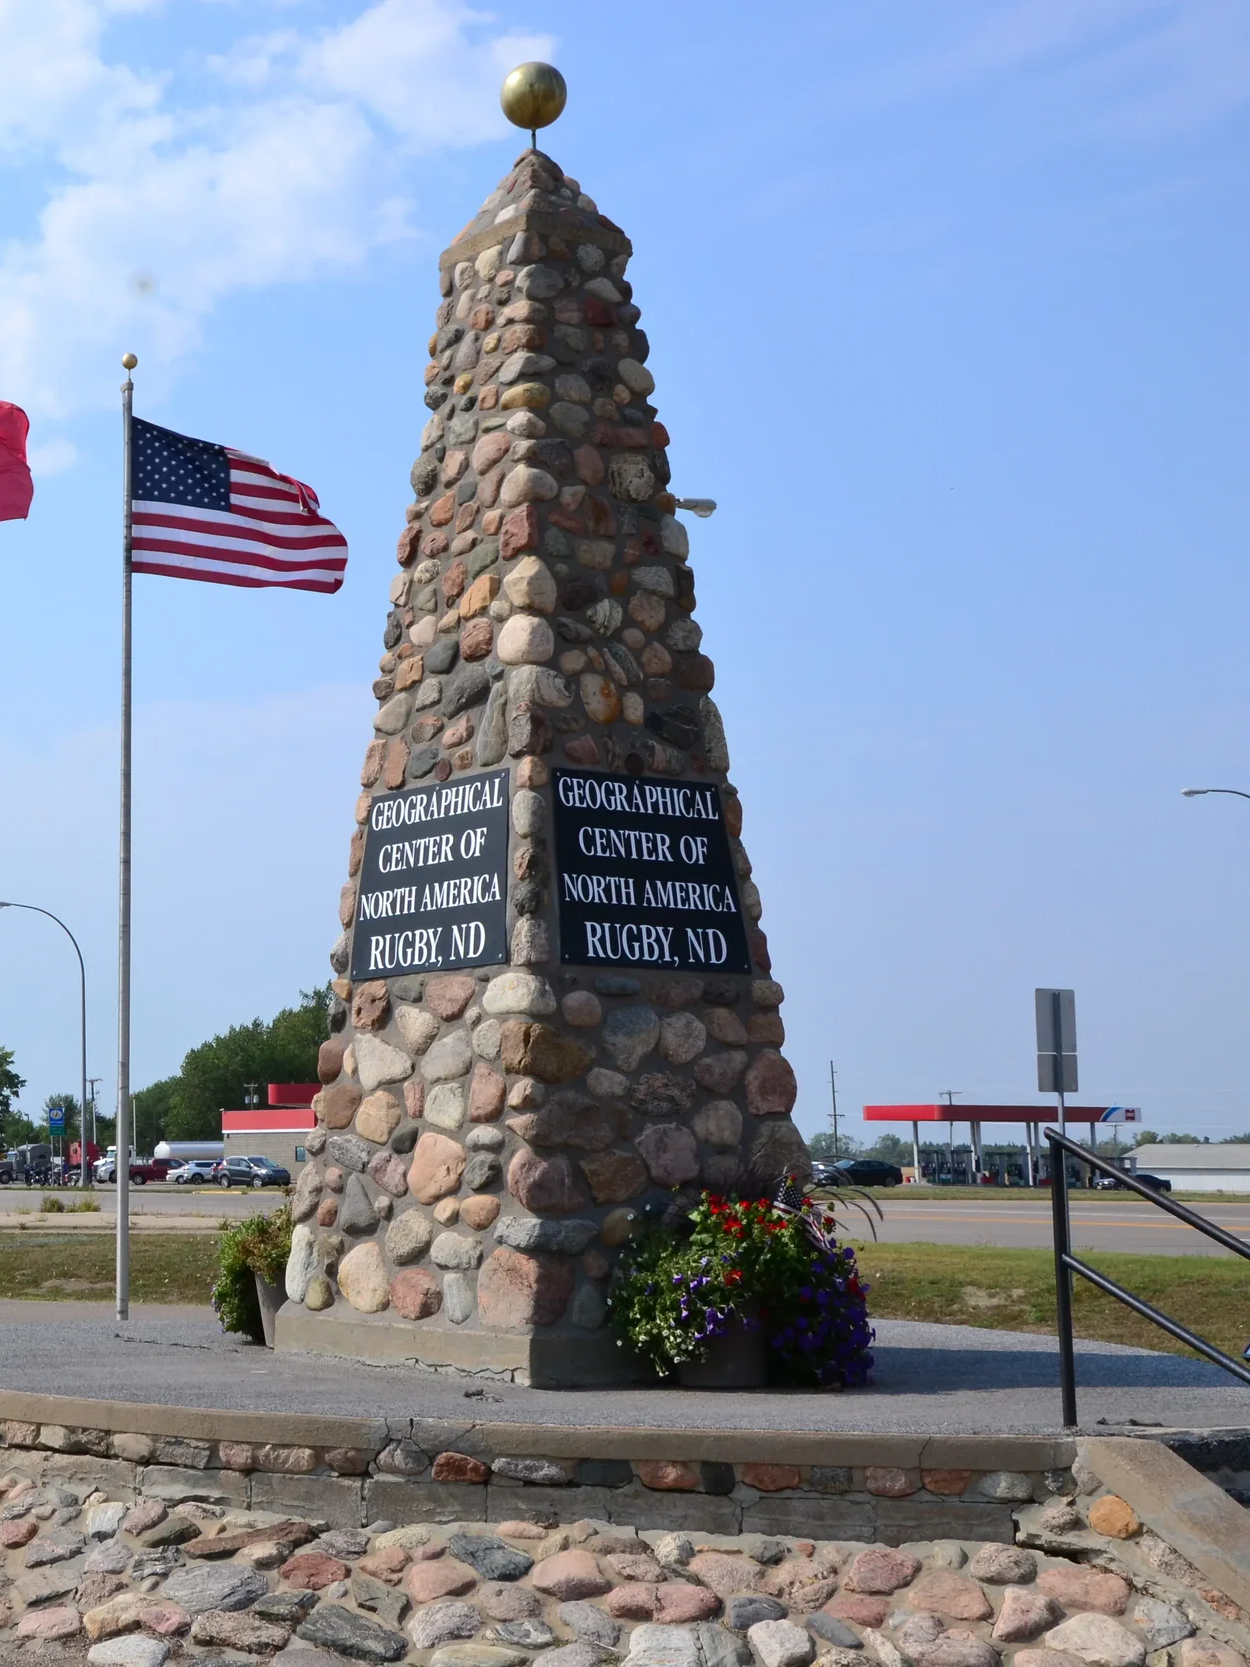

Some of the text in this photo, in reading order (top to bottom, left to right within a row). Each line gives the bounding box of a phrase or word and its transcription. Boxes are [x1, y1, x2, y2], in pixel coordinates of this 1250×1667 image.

[372, 778, 503, 831] GEOGRAPHICAL
[558, 776, 719, 820] GEOGRAPHICAL
[378, 827, 487, 873] CENTER OF
[578, 826, 708, 864] CENTER OF
[359, 872, 501, 921] NORTH AMERICA
[562, 873, 737, 912] NORTH AMERICA
[369, 921, 486, 970] RUGBY, ND
[584, 921, 727, 967] RUGBY, ND
